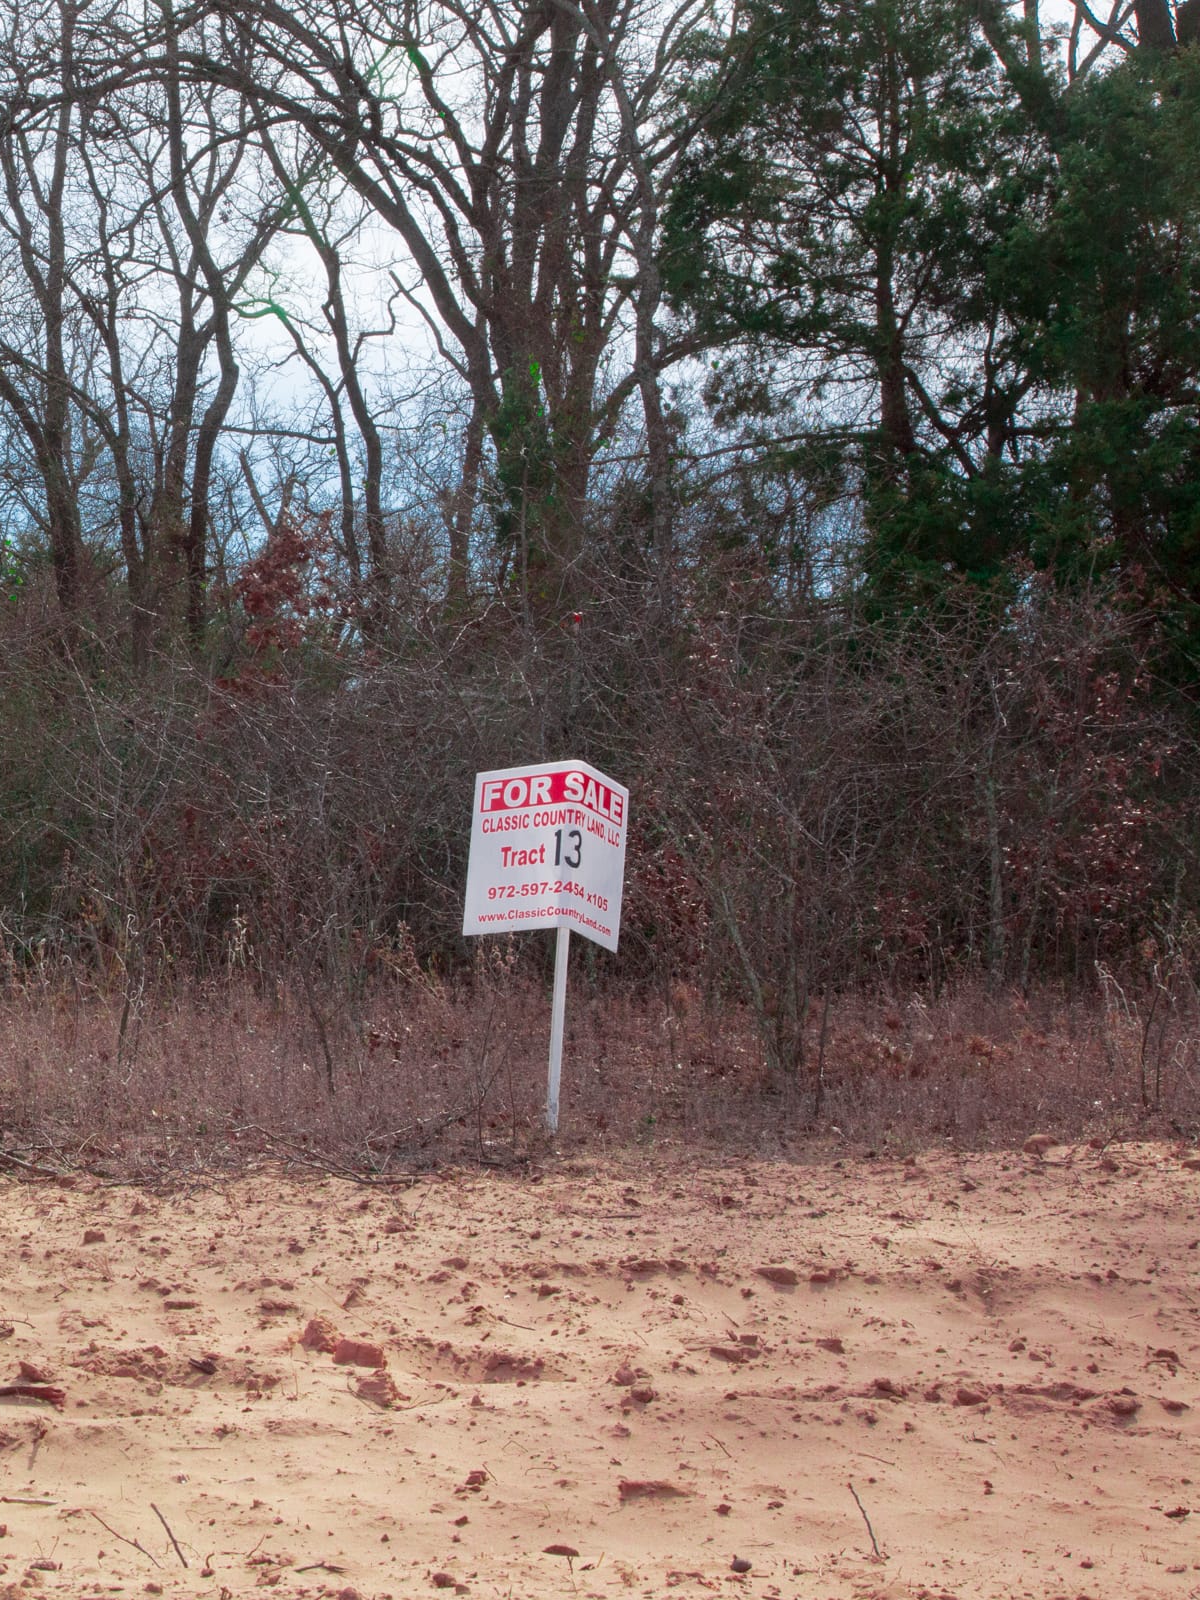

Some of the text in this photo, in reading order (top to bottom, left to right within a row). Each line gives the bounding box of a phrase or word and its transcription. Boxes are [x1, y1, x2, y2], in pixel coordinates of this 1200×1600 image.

[483, 772, 622, 825] FOR SALE
[482, 813, 529, 833] CLASSIC
[533, 809, 586, 828] COUNTRY
[587, 817, 606, 841] LAND,
[501, 829, 582, 869] Tract 13
[488, 880, 608, 912] 972-597-2454 x105
[478, 906, 611, 937] www.ClassicCountryLand.com
